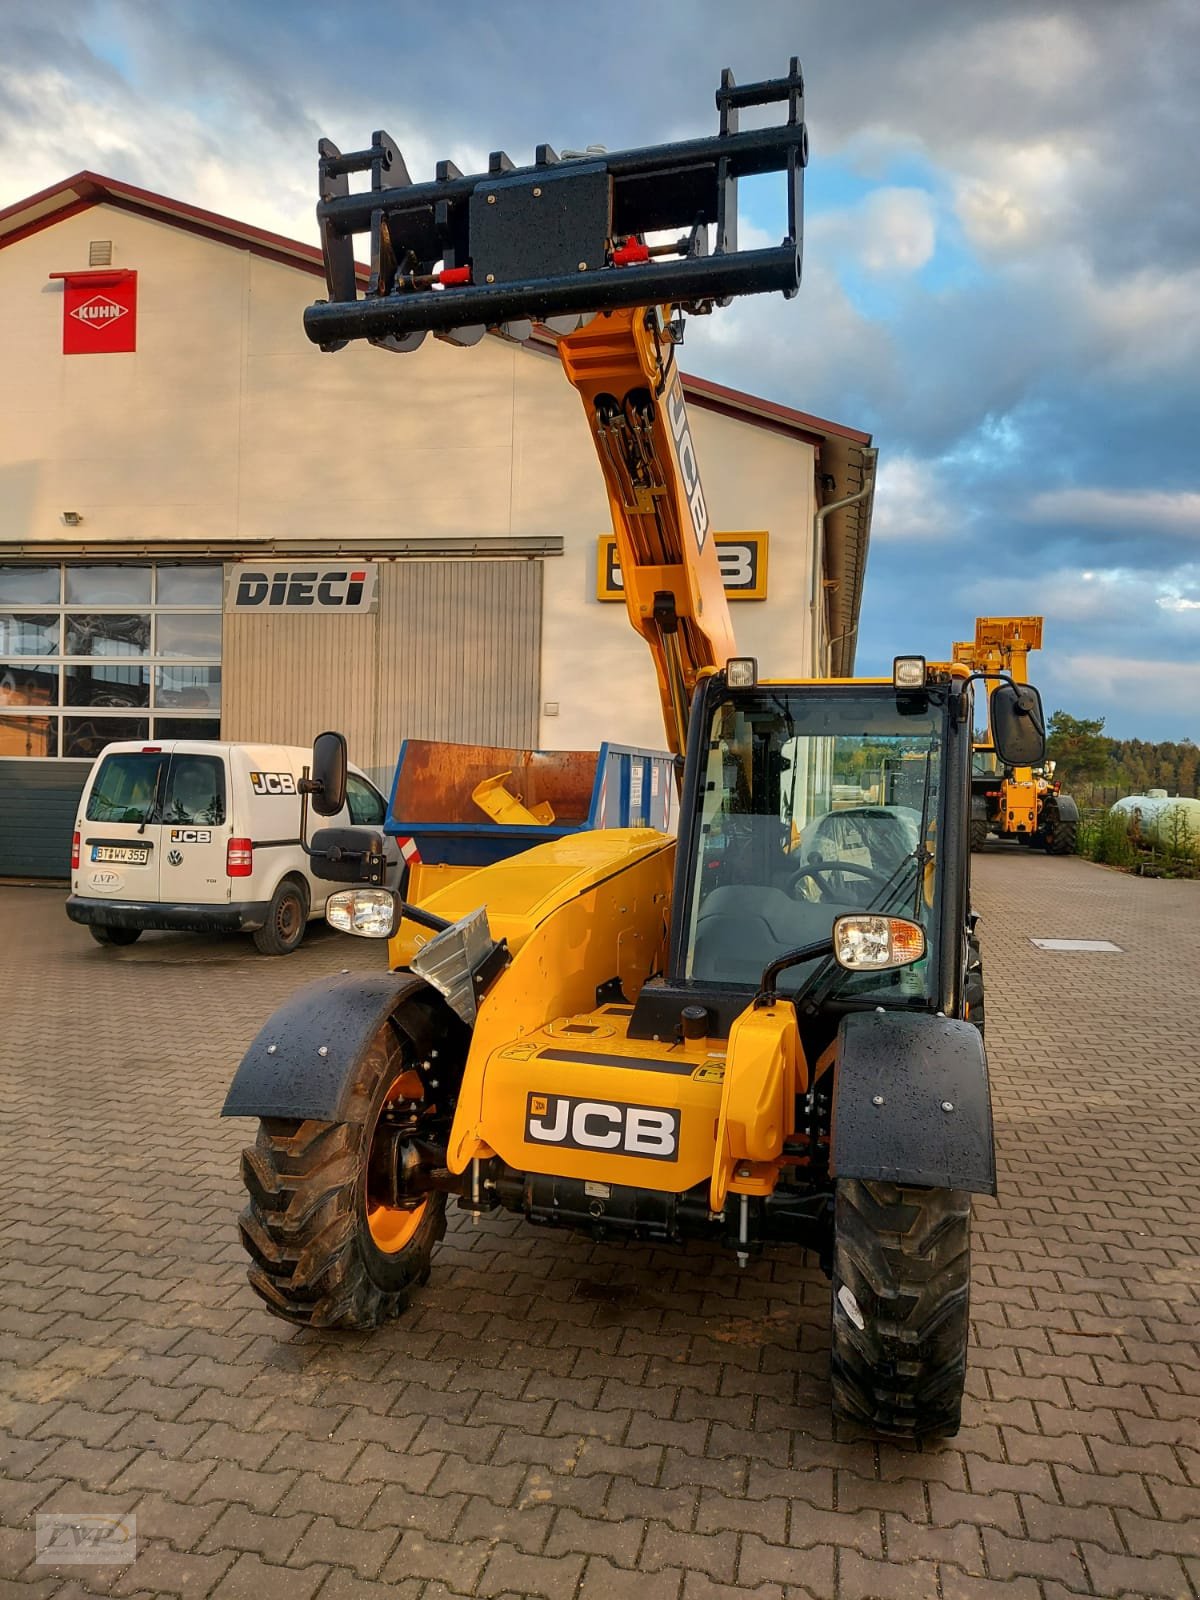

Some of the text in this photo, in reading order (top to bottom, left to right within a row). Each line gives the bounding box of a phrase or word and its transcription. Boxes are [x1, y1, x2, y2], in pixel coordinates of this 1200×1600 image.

[79, 306, 120, 318] KUHN
[668, 391, 708, 546] JCB
[236, 572, 366, 605] DIECI
[253, 773, 296, 793] JCB
[171, 831, 211, 842] JCB
[97, 848, 146, 861] BT WW 355
[93, 874, 115, 883] LVP
[529, 1100, 675, 1155] JCB
